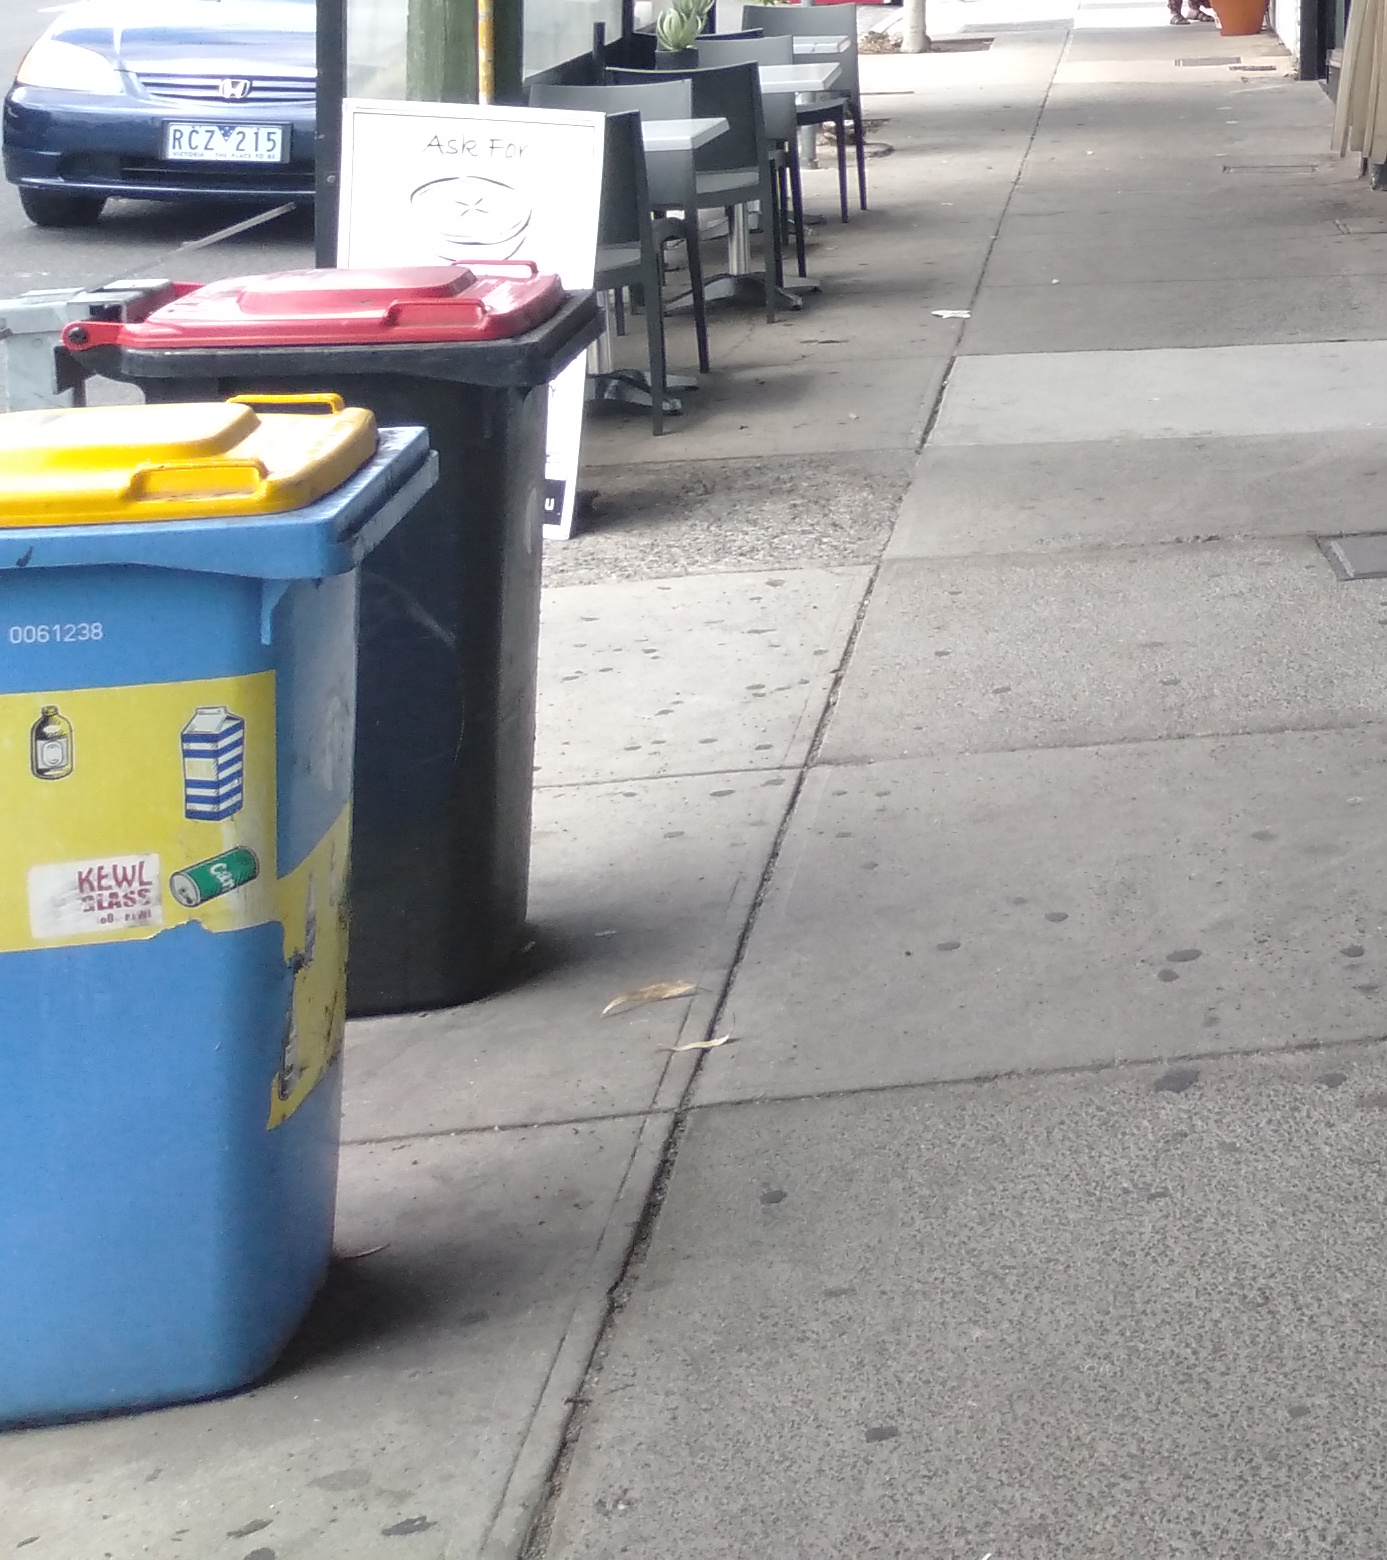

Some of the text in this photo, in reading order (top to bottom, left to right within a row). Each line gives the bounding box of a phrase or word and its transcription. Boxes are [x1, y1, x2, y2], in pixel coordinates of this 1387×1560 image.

[171, 128, 278, 153] RCZ 215
[422, 134, 530, 160] Ask For
[9, 622, 104, 644] 0061238
[77, 860, 153, 894] KEWL
